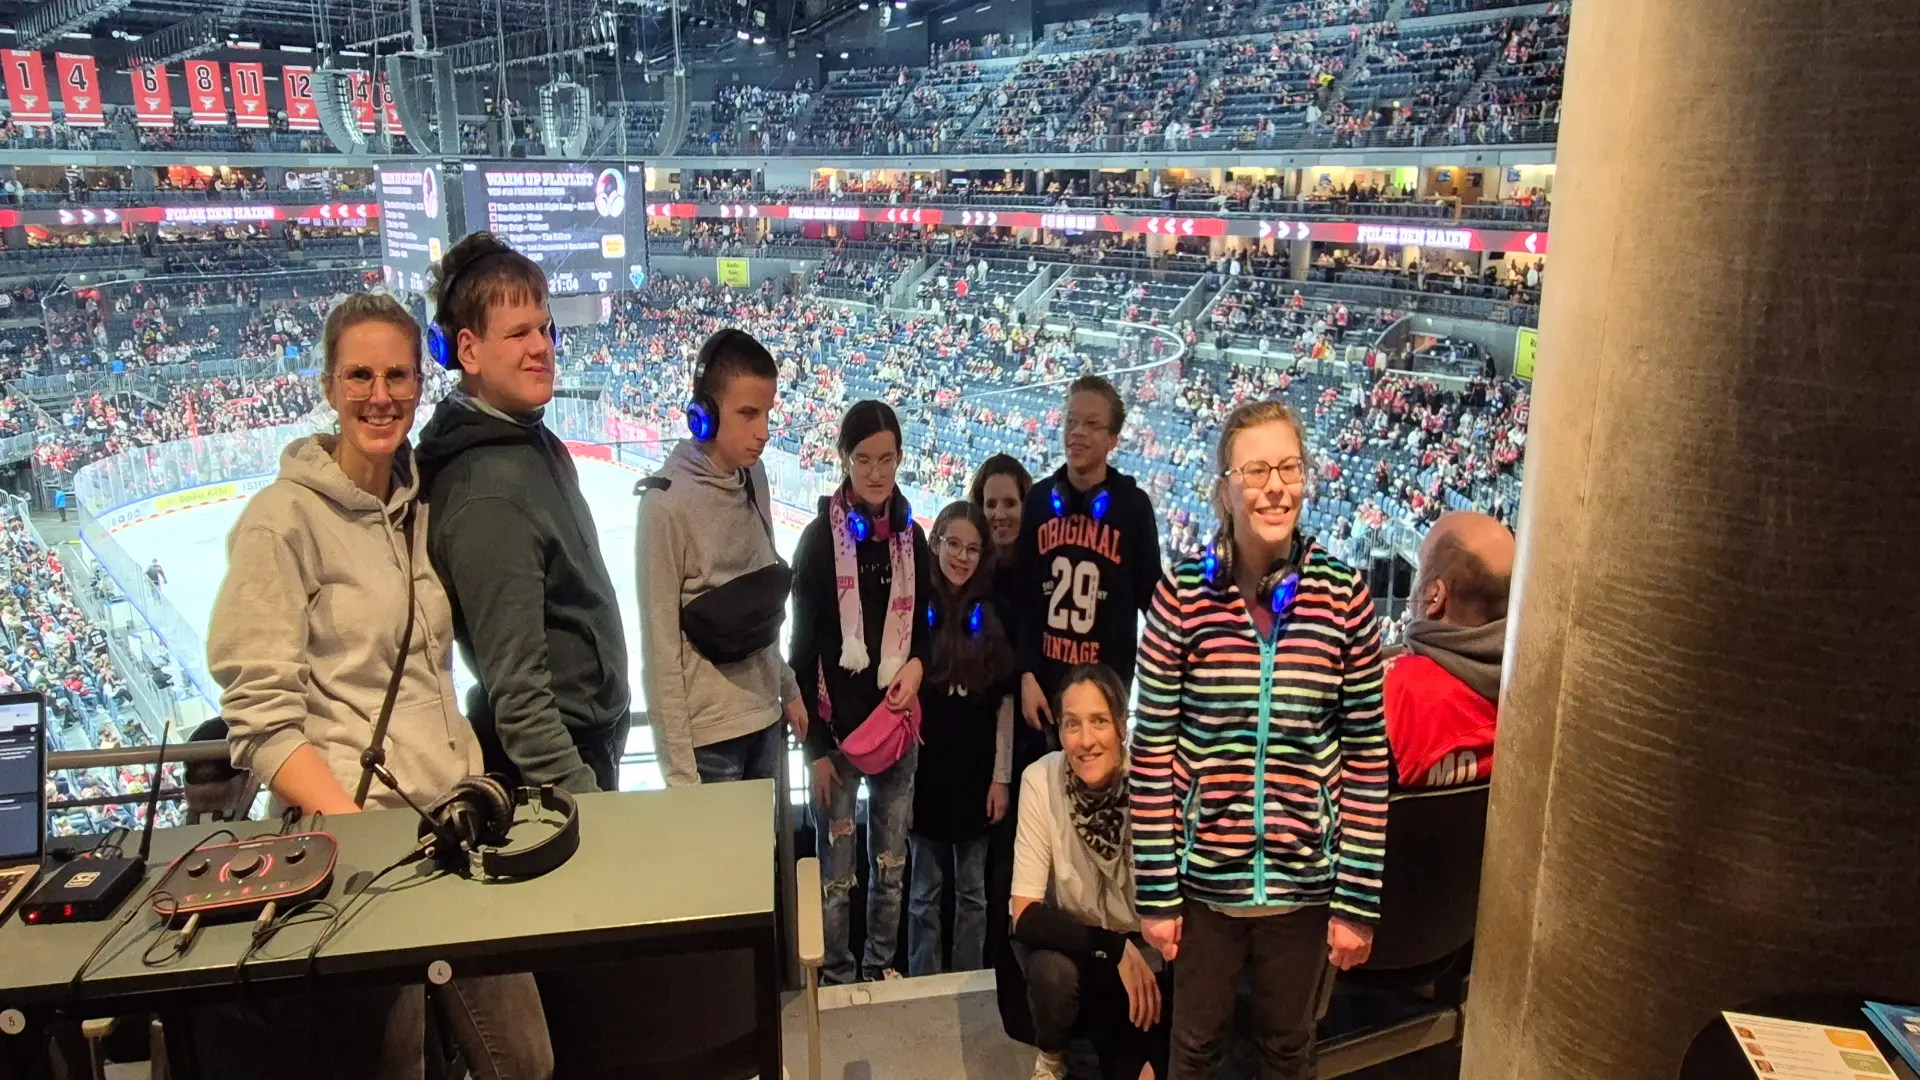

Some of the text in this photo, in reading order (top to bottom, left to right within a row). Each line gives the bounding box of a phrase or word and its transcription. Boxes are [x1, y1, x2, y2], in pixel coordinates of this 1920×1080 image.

[17, 61, 32, 91] 1
[68, 63, 89, 93] 4
[141, 68, 158, 93] 6
[195, 64, 214, 93] 8
[237, 69, 261, 96] 11
[288, 73, 312, 99] 12
[485, 172, 595, 187] WARM UP PLAYLIST
[206, 207, 233, 220] DEN
[1357, 225, 1472, 250] FOLGE DEN HAIEN
[598, 279, 607, 292] 0
[207, 483, 229, 497] Köln
[1037, 514, 1122, 565] ORIGINAL
[1047, 556, 1100, 634] 29
[1043, 632, 1100, 665] VINTAGE
